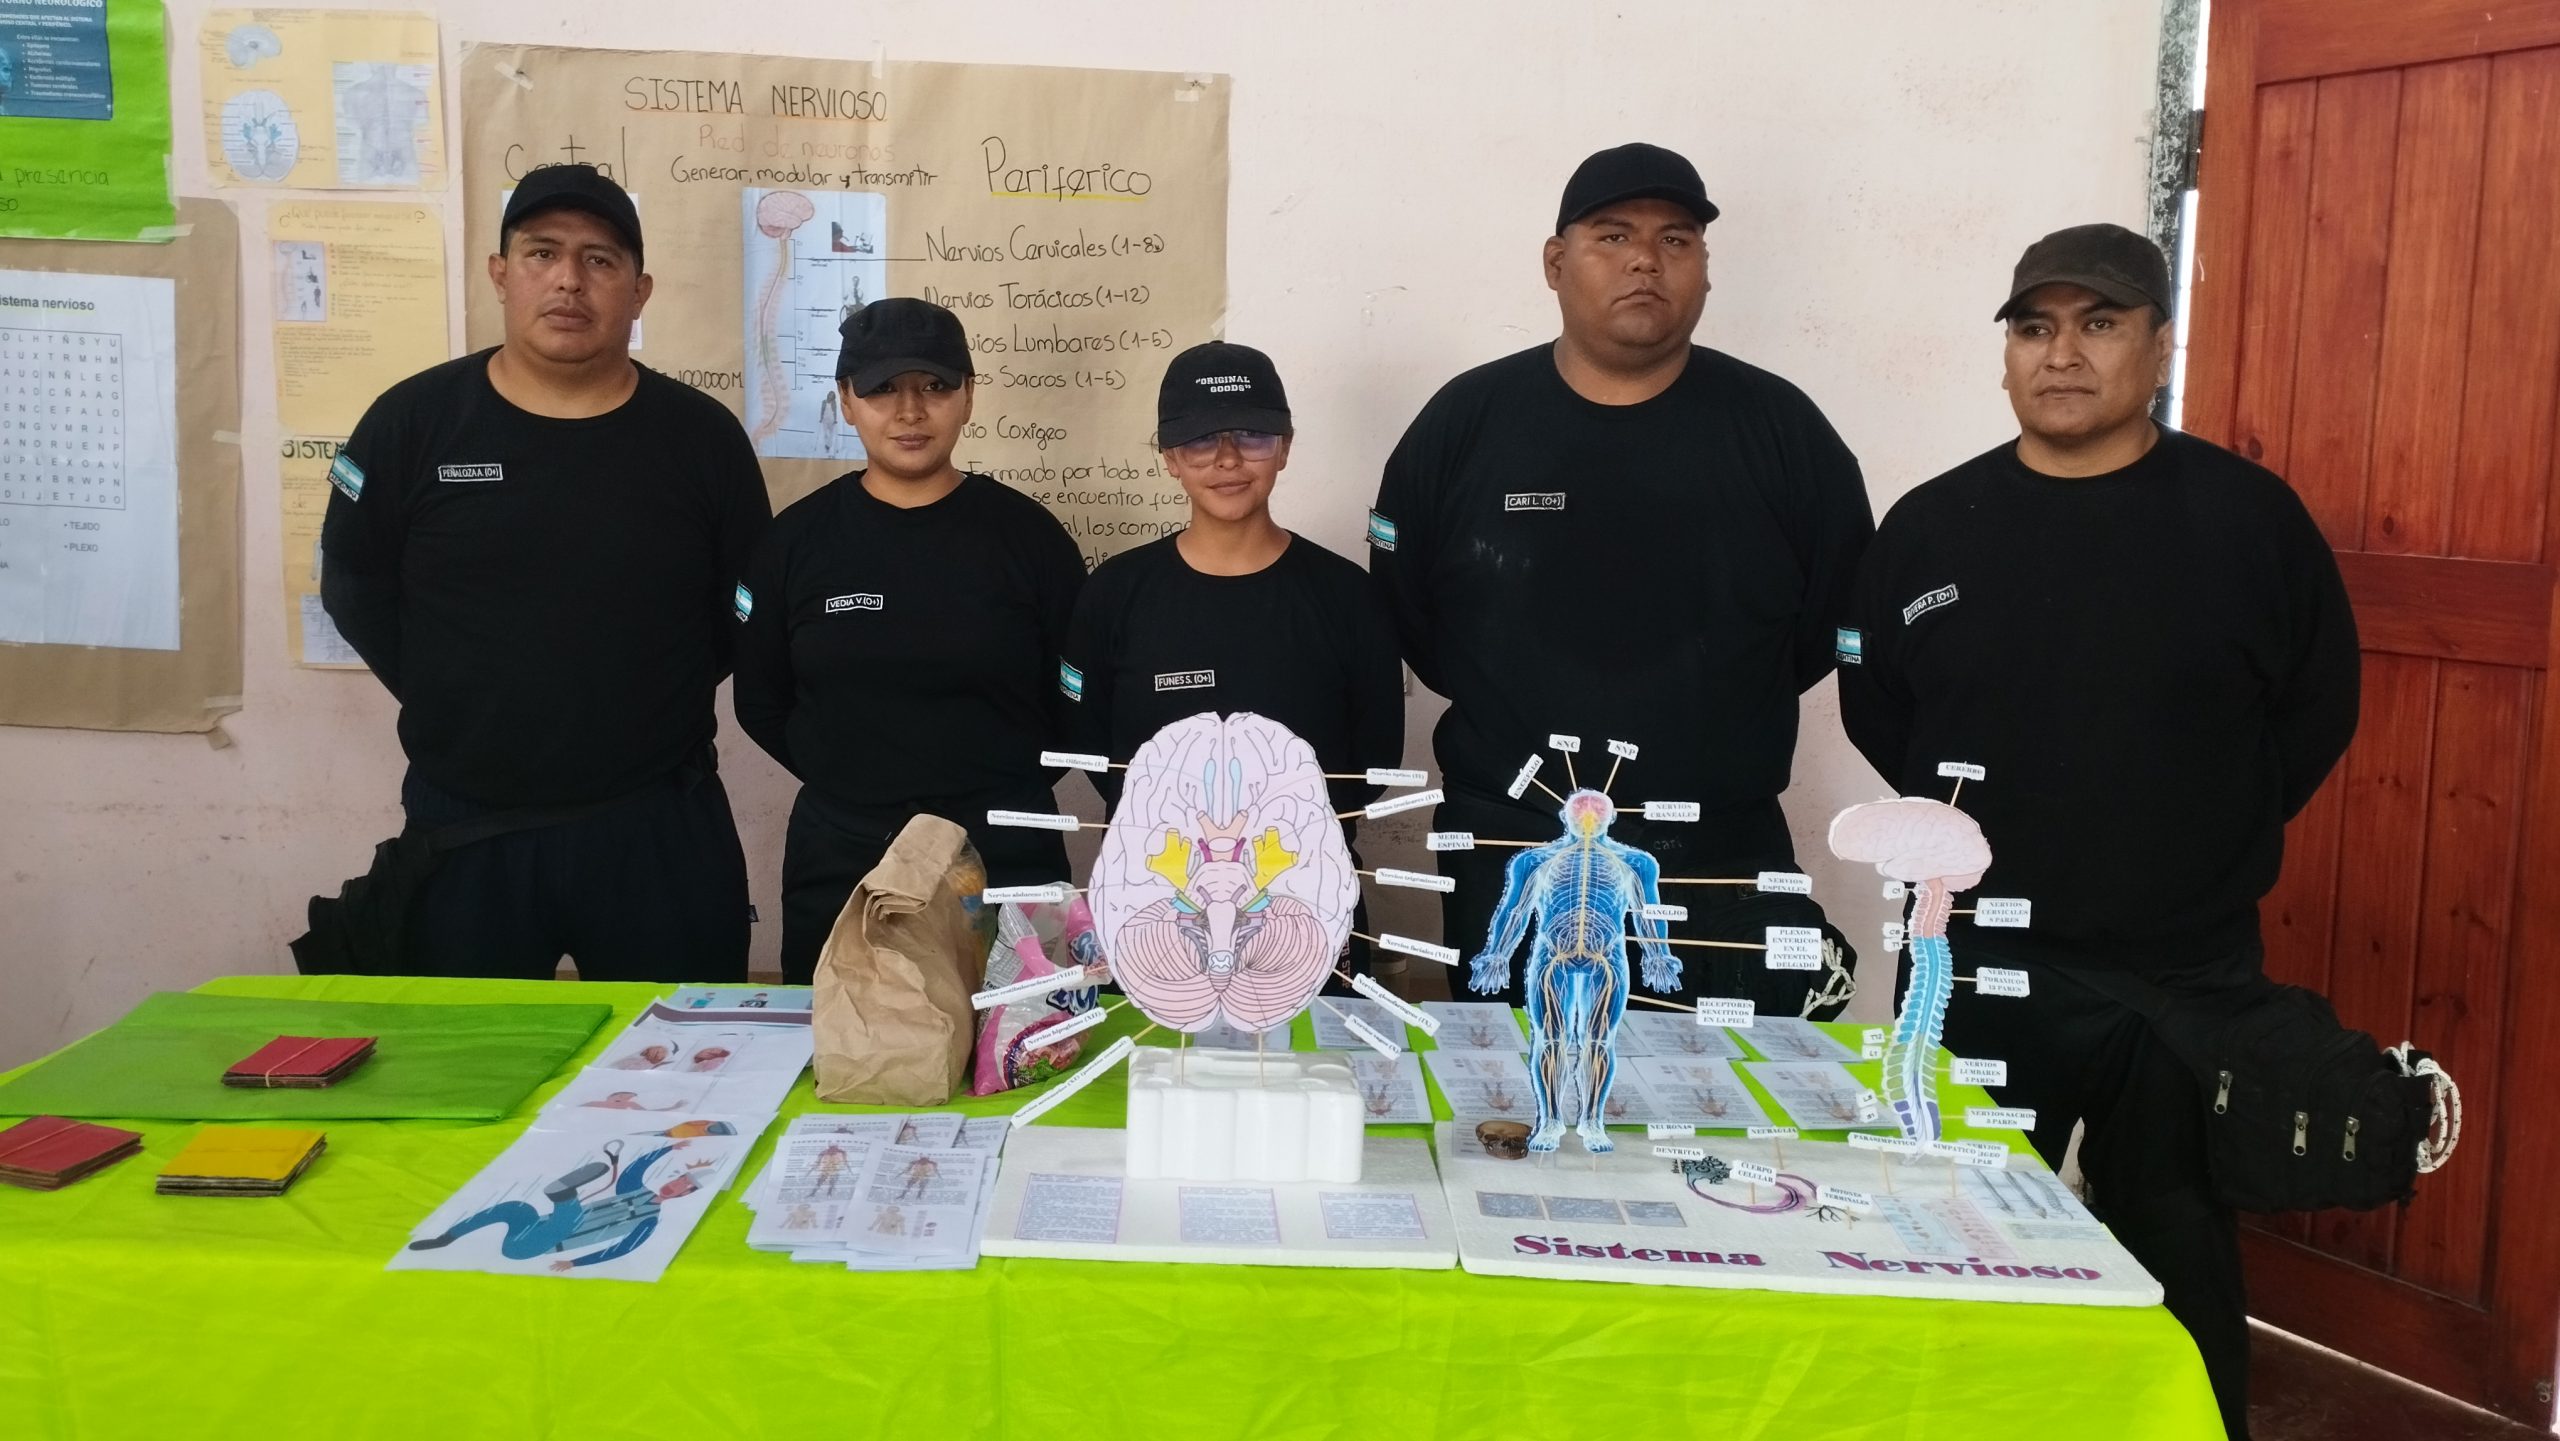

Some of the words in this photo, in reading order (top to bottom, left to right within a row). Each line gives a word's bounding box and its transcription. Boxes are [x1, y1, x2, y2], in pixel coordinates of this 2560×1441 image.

[625, 76, 744, 114] SISTEMA
[772, 84, 887, 121] NERVIOSO
[700, 123, 745, 153] Red
[763, 128, 791, 157] de
[802, 140, 895, 163] neuronas
[15, 168, 109, 188] presencia
[757, 160, 832, 184] modular
[851, 166, 939, 187] transmitir
[925, 226, 1004, 262] Nervios
[1009, 224, 1107, 262] Cervicales
[0, 294, 39, 308] istema
[42, 298, 95, 311] nervioso
[998, 282, 1093, 309] Torácicos
[1096, 285, 1150, 308] (1-12)
[1014, 323, 1115, 354] Lumbares
[1120, 329, 1173, 351] (1-5)
[1000, 365, 1067, 389] Sacros
[1075, 370, 1126, 390] (1-5)
[997, 415, 1067, 451] Coxigeo
[1063, 466, 1094, 487] por
[1098, 457, 1139, 481] todo
[1147, 459, 1161, 478] el
[1057, 487, 1143, 507] encuentra
[1149, 492, 1191, 511] fuer
[1509, 497, 1530, 506] CARI
[69, 521, 100, 531] TEJIDO
[1087, 516, 1115, 536] los
[69, 542, 98, 553] PLEXO
[830, 598, 854, 609] VEDIA
[1158, 675, 1185, 687] FUNES
[1556, 739, 1578, 750] SNC
[1615, 743, 1636, 757] SNP
[1945, 763, 1984, 775] CEREBRO
[1514, 760, 1540, 797] ENCEFALO
[1656, 803, 1692, 811] NERVIOS
[1650, 810, 1697, 819] CRANEALES
[1768, 877, 1803, 885] NERVIOS
[1762, 884, 1808, 893] ESPINALES
[1646, 909, 1687, 917] GANGLIOS
[1699, 1001, 1753, 1009] RECEPTORES
[1971, 1109, 2005, 1118] NERVIOS
[1992, 1118, 2017, 1126] PARES
[1853, 1133, 1916, 1147] PARASIMPATICO
[1656, 1147, 1701, 1157] DENTRITAS
[1933, 1143, 1976, 1154] SIMPATICO
[1741, 1161, 1773, 1174] CUERPO
[1738, 1169, 1773, 1184] CELULAR
[1824, 1192, 1870, 1206] TERMINALES
[1513, 1234, 1767, 1267] Sistema
[1816, 1250, 2103, 1281] Nervioso
